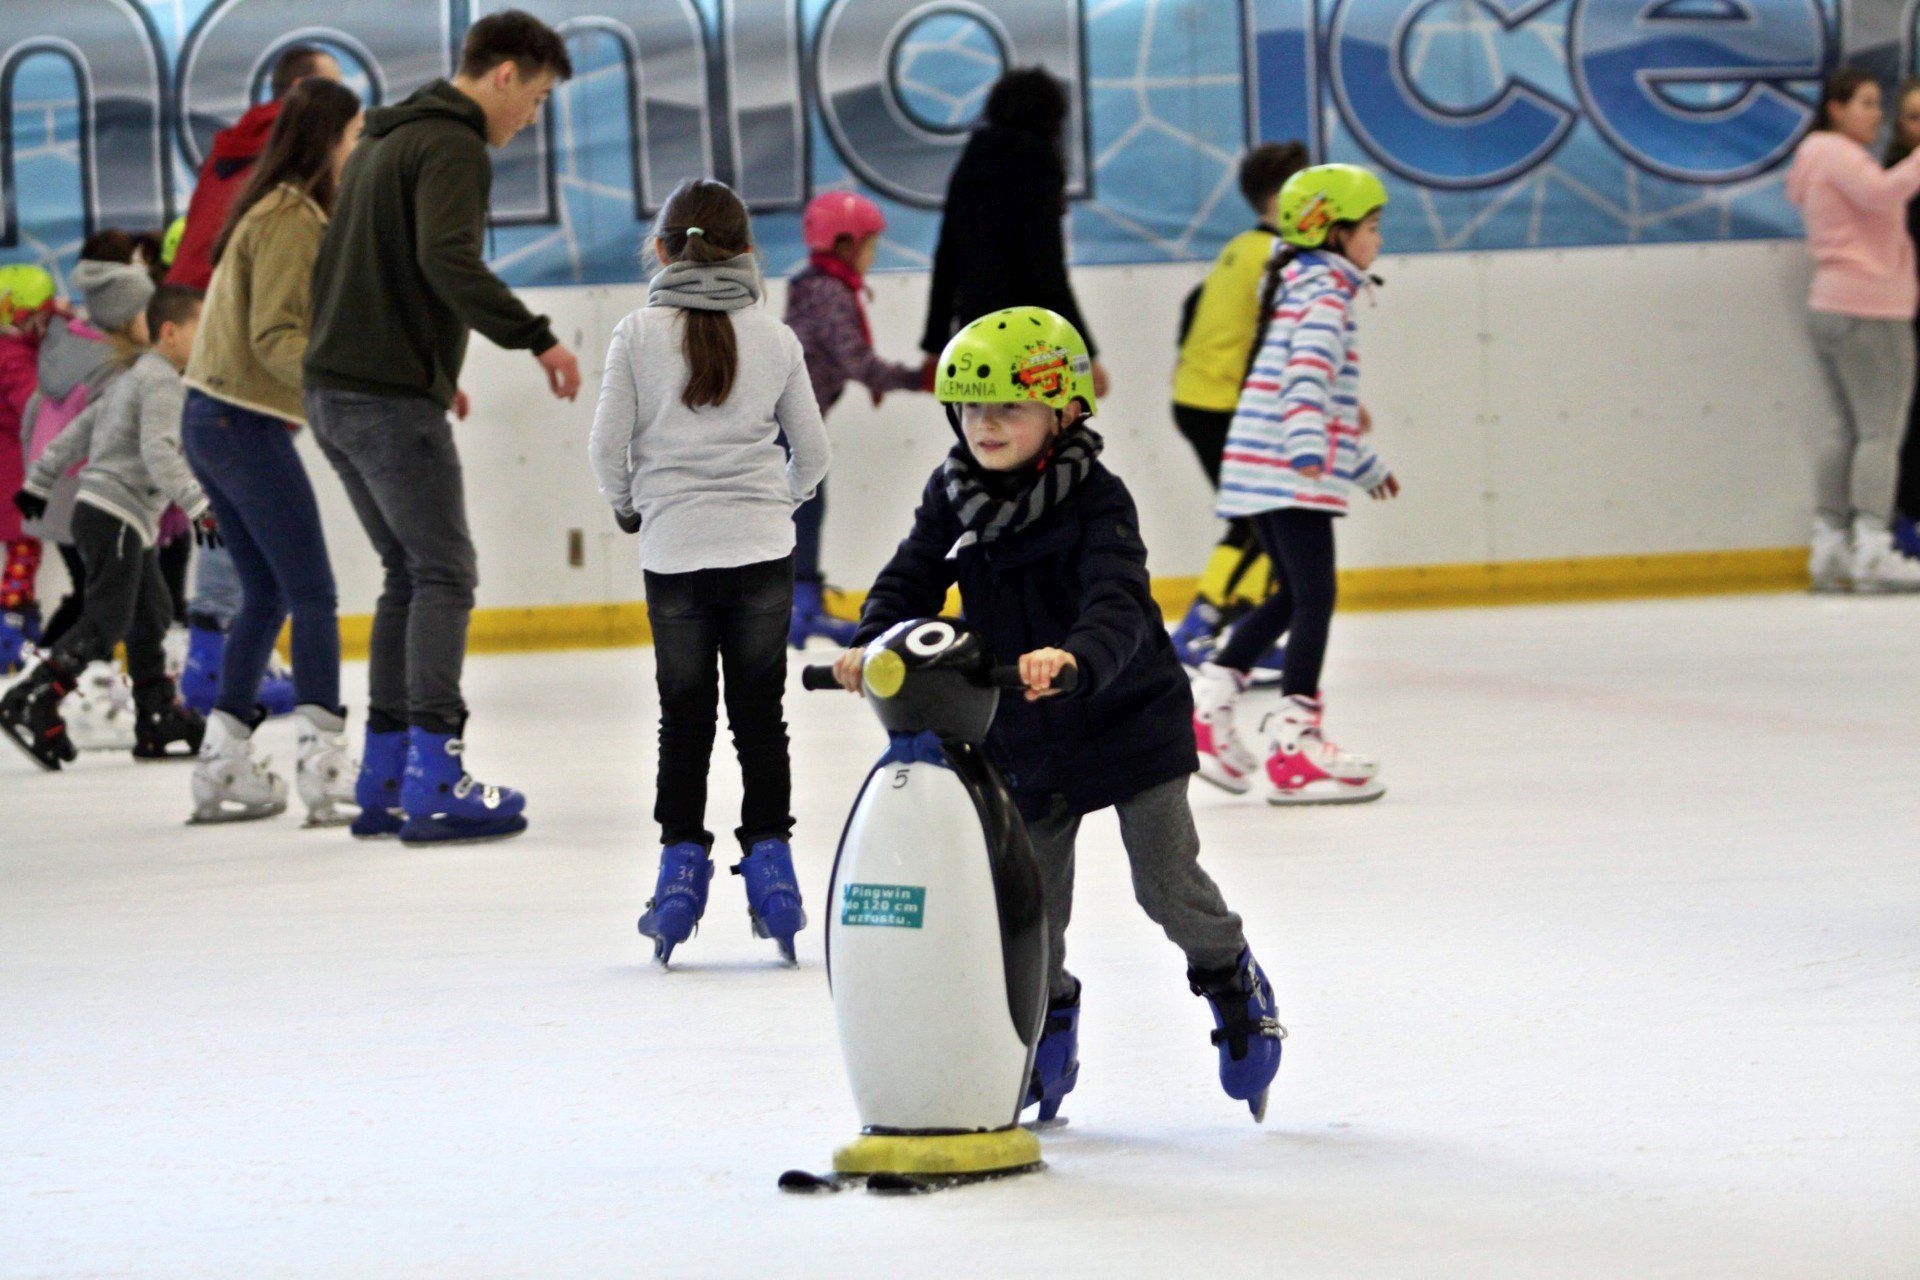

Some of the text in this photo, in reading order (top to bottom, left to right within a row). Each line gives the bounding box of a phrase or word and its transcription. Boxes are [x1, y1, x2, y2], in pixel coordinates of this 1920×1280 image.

[892, 769, 910, 789] 5
[852, 886, 911, 900] Pingwin
[863, 900, 890, 911] 120
[894, 902, 918, 913] cm
